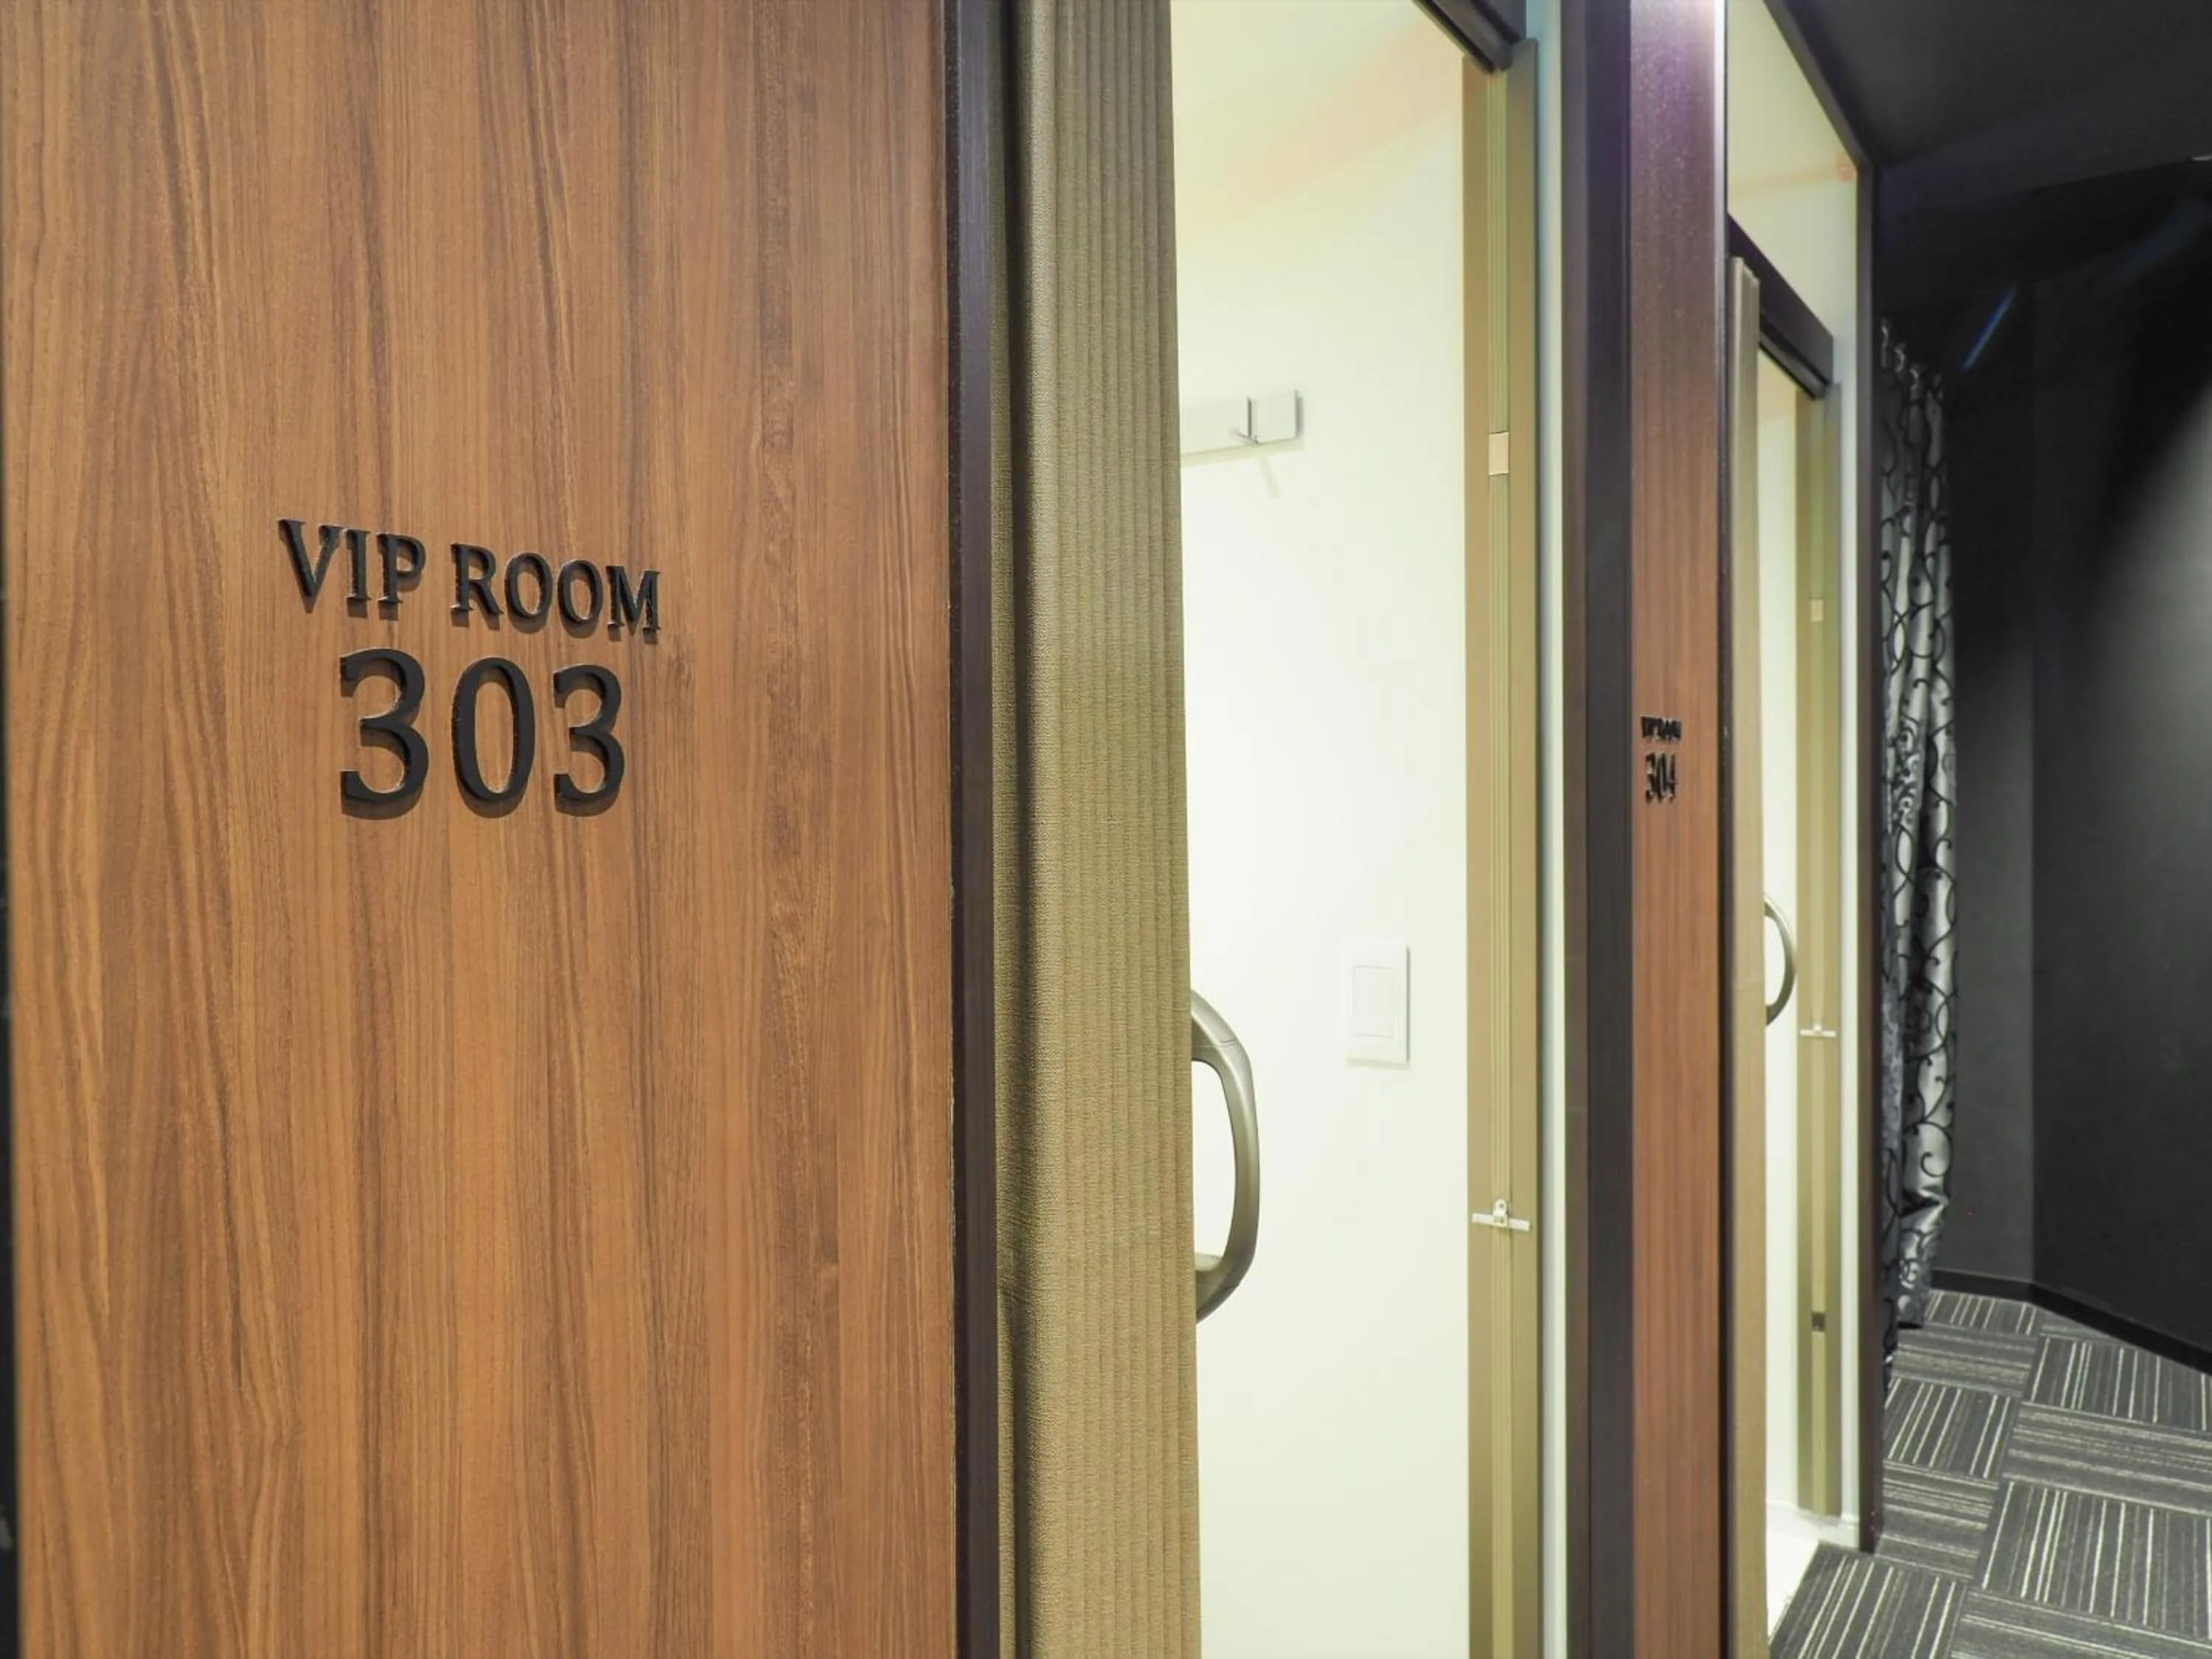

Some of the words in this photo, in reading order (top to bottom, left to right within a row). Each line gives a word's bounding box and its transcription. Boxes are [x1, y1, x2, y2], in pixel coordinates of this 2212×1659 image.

[277, 518, 426, 611] VIP
[450, 542, 661, 639] ROOM
[339, 647, 625, 810] 303
[1645, 752, 1677, 803] 304
